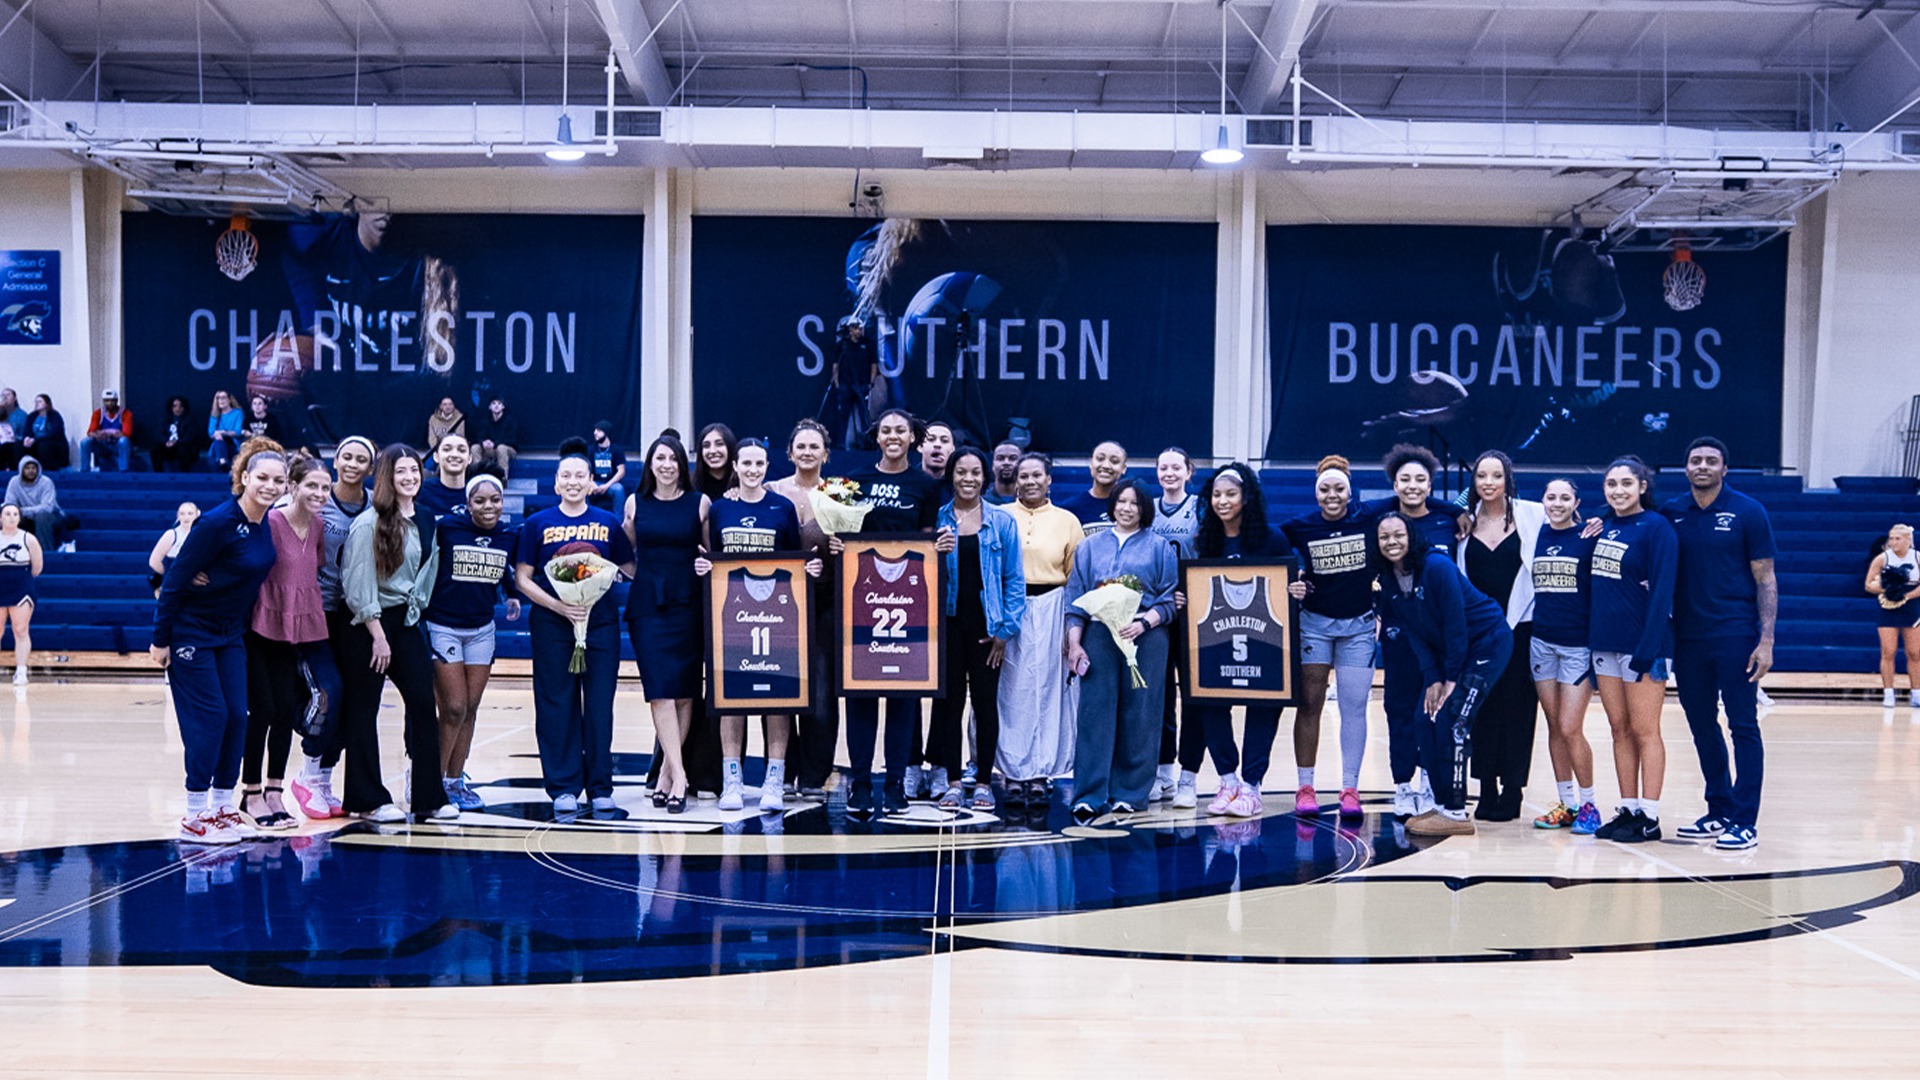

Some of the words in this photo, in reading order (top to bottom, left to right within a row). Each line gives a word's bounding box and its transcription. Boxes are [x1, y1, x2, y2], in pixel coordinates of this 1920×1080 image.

[38, 257, 46, 268] C
[7, 270, 43, 279] General
[2, 282, 48, 291] Admission
[188, 308, 577, 373] CHARLESTON
[796, 314, 1109, 380] SUTHERN
[1328, 322, 1722, 389] BUCCANEERS
[870, 483, 900, 499] BOSS
[543, 521, 609, 545] ESPAÑA
[865, 591, 915, 605] Charleston
[736, 610, 785, 623] Charleston
[872, 607, 908, 639] 22
[1212, 615, 1267, 633] CHARLESTON
[751, 626, 770, 655] 11
[868, 640, 911, 655] Southern
[1232, 633, 1249, 662] 5
[738, 658, 781, 672] Southern
[1220, 664, 1262, 678] SOUTHERN
